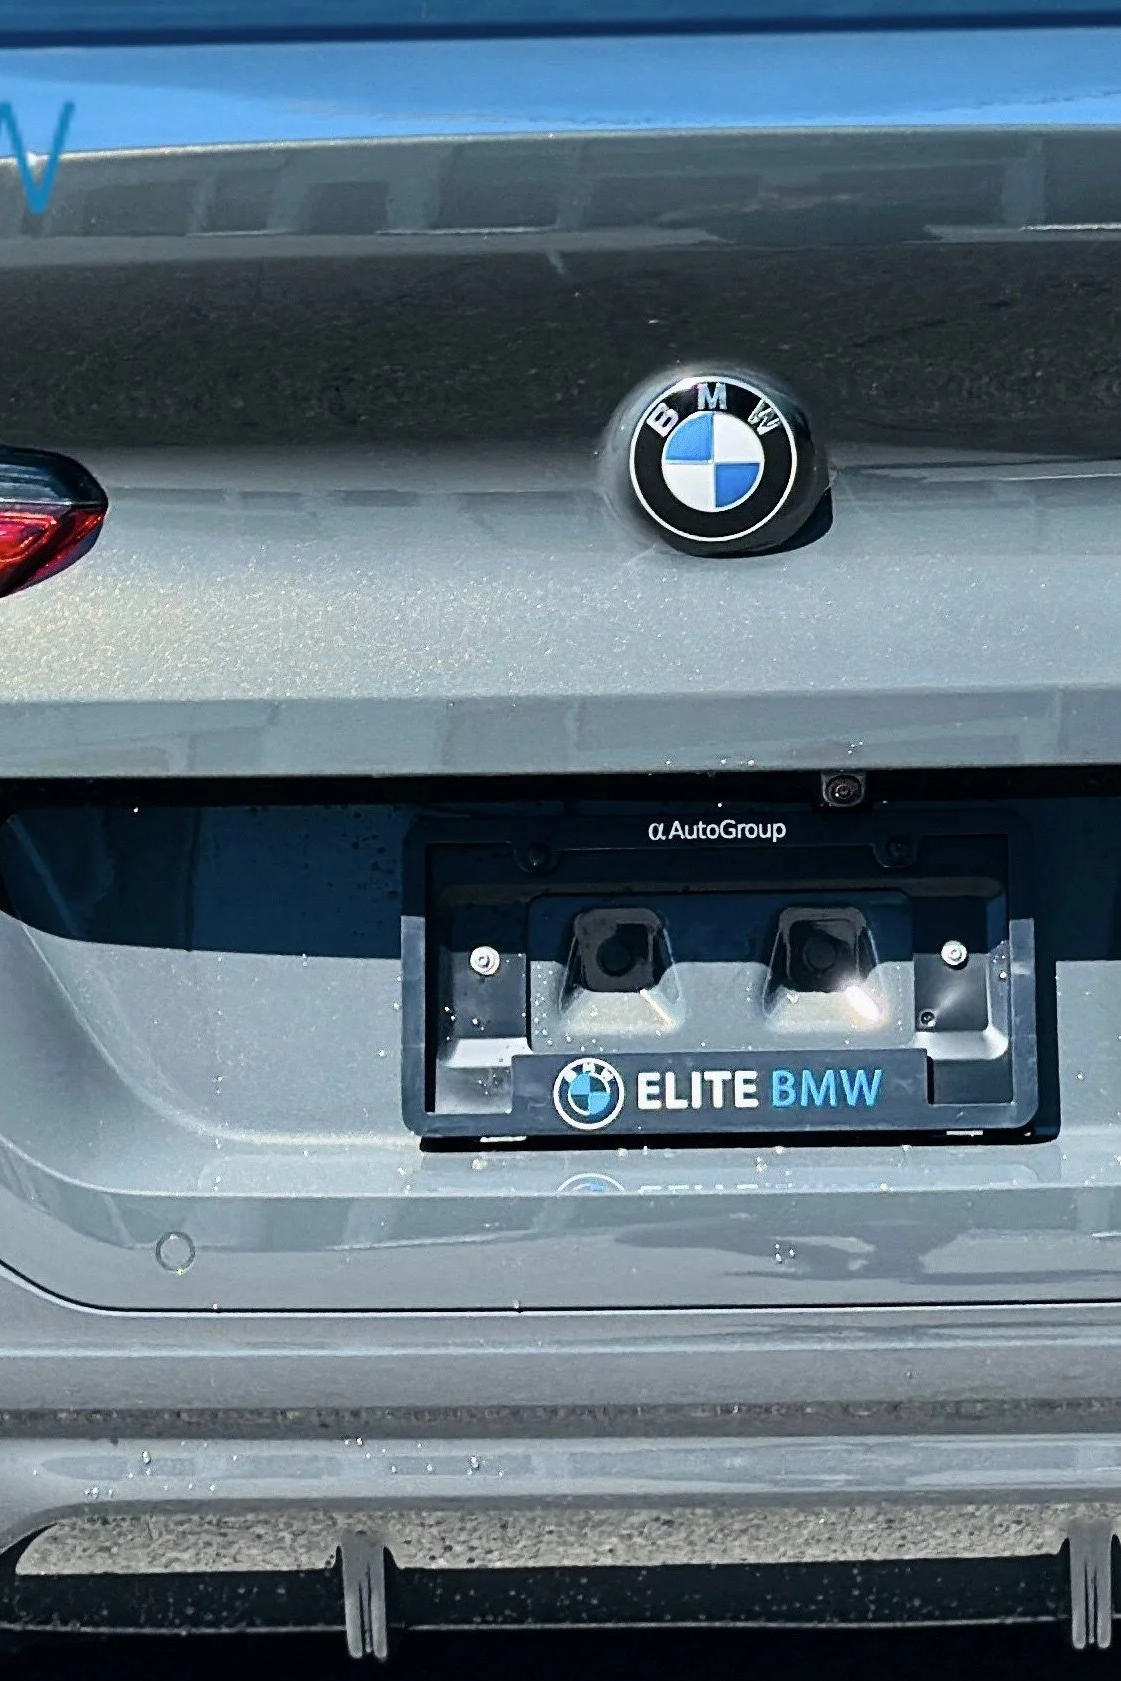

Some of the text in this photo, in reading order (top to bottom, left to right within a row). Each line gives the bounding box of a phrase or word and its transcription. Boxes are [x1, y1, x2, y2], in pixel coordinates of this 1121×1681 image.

[646, 382, 780, 437] BMW
[637, 1069, 882, 1110] ELITE BMW
